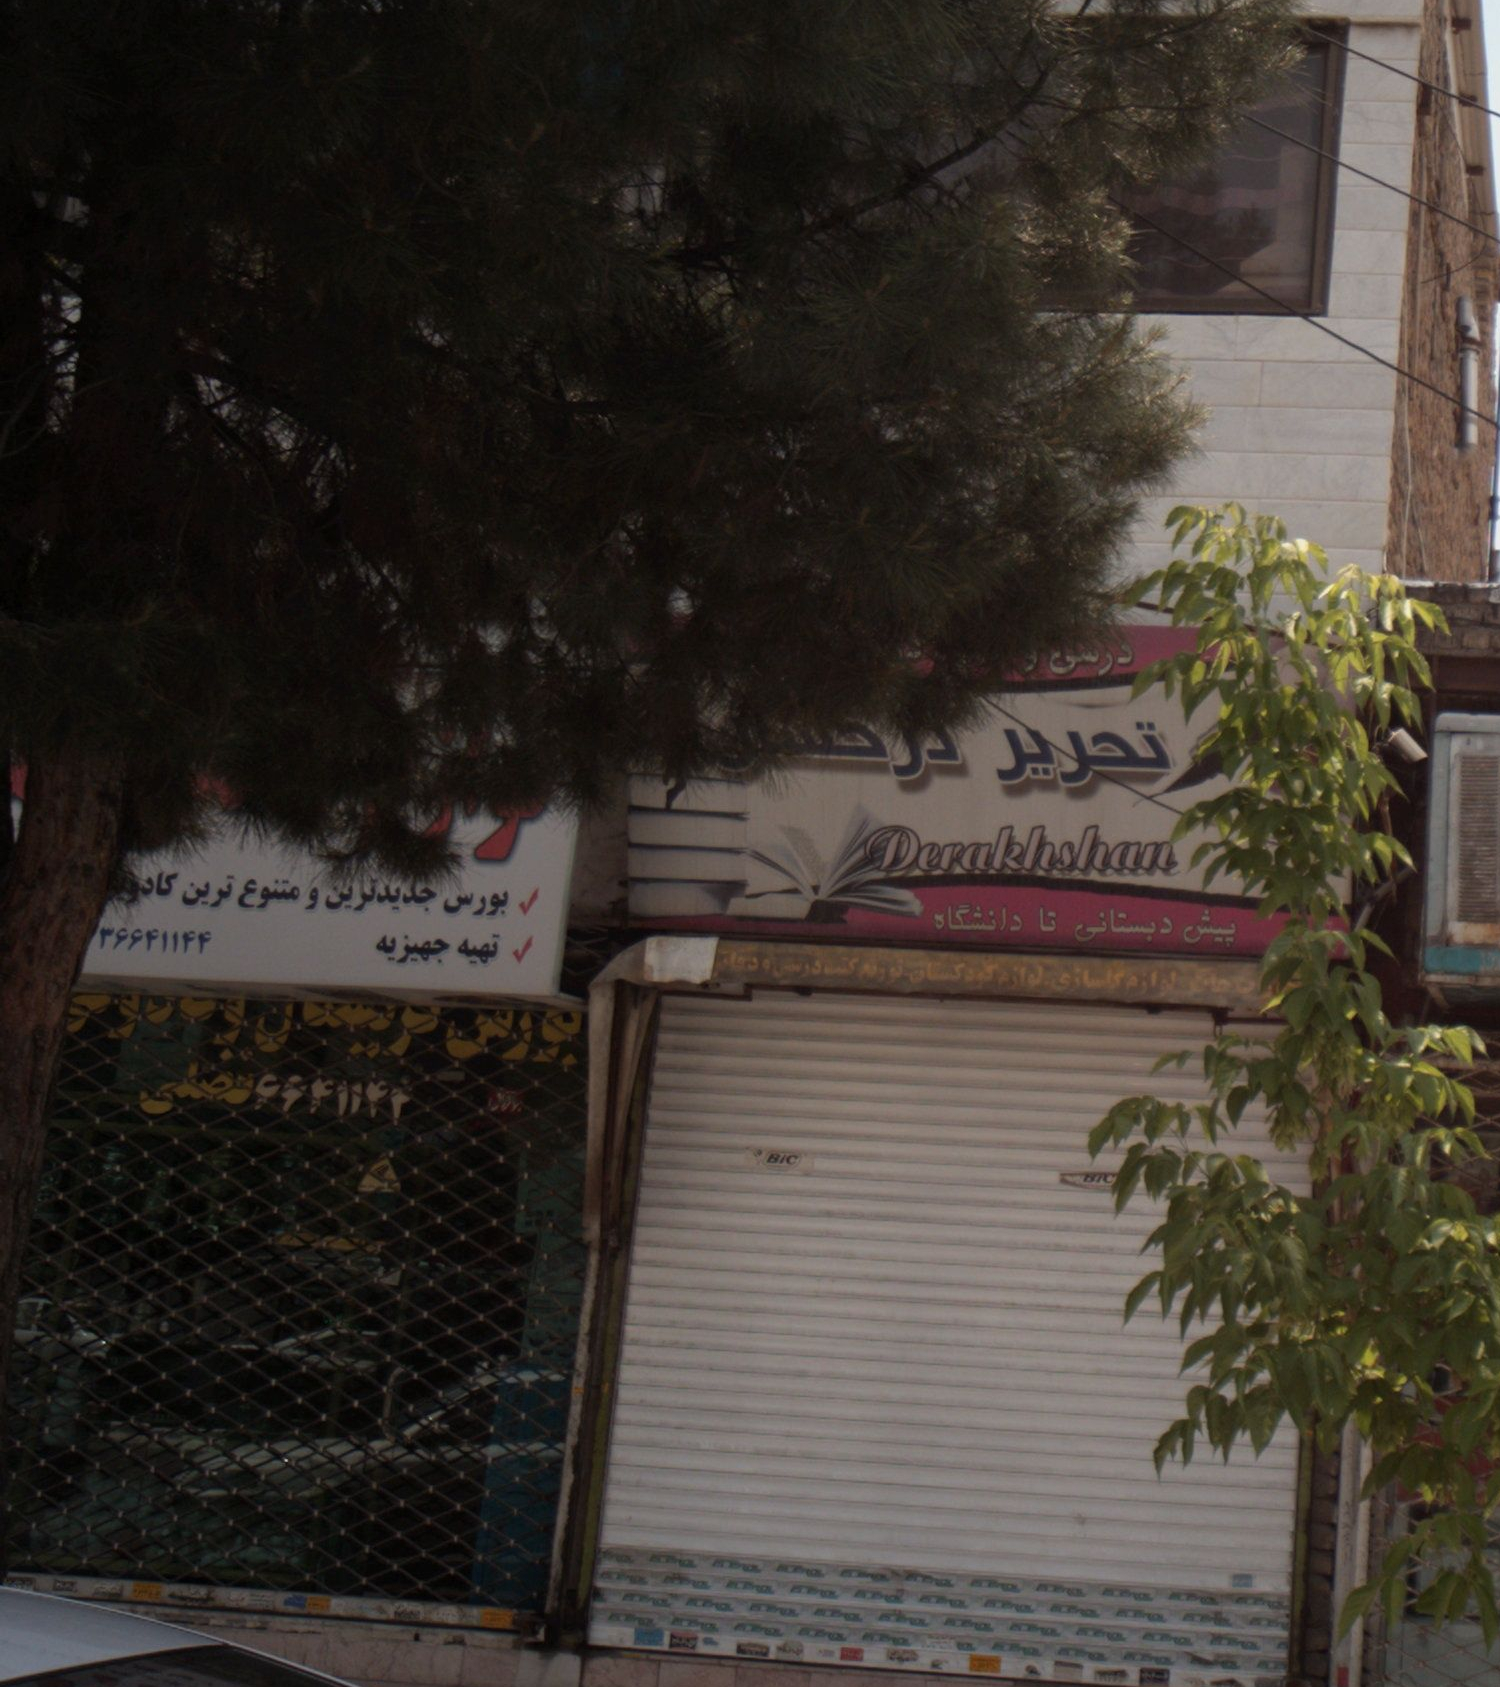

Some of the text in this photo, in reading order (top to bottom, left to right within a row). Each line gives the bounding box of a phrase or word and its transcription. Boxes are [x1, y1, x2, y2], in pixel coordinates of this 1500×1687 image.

[996, 722, 1171, 785] تحریر
[864, 824, 1178, 877] Derakhshan
[182, 875, 235, 908] ترین
[238, 877, 299, 909] متنوع
[304, 885, 320, 910] و
[326, 879, 436, 913] جدیدترین
[444, 889, 509, 917] بورس
[932, 903, 1237, 945] پیش دبستانی تا دانشگاه
[99, 926, 500, 964] تهیه جهیزیه ۳۶۶۴۱۱۴۴
[766, 1153, 799, 1165] BIC
